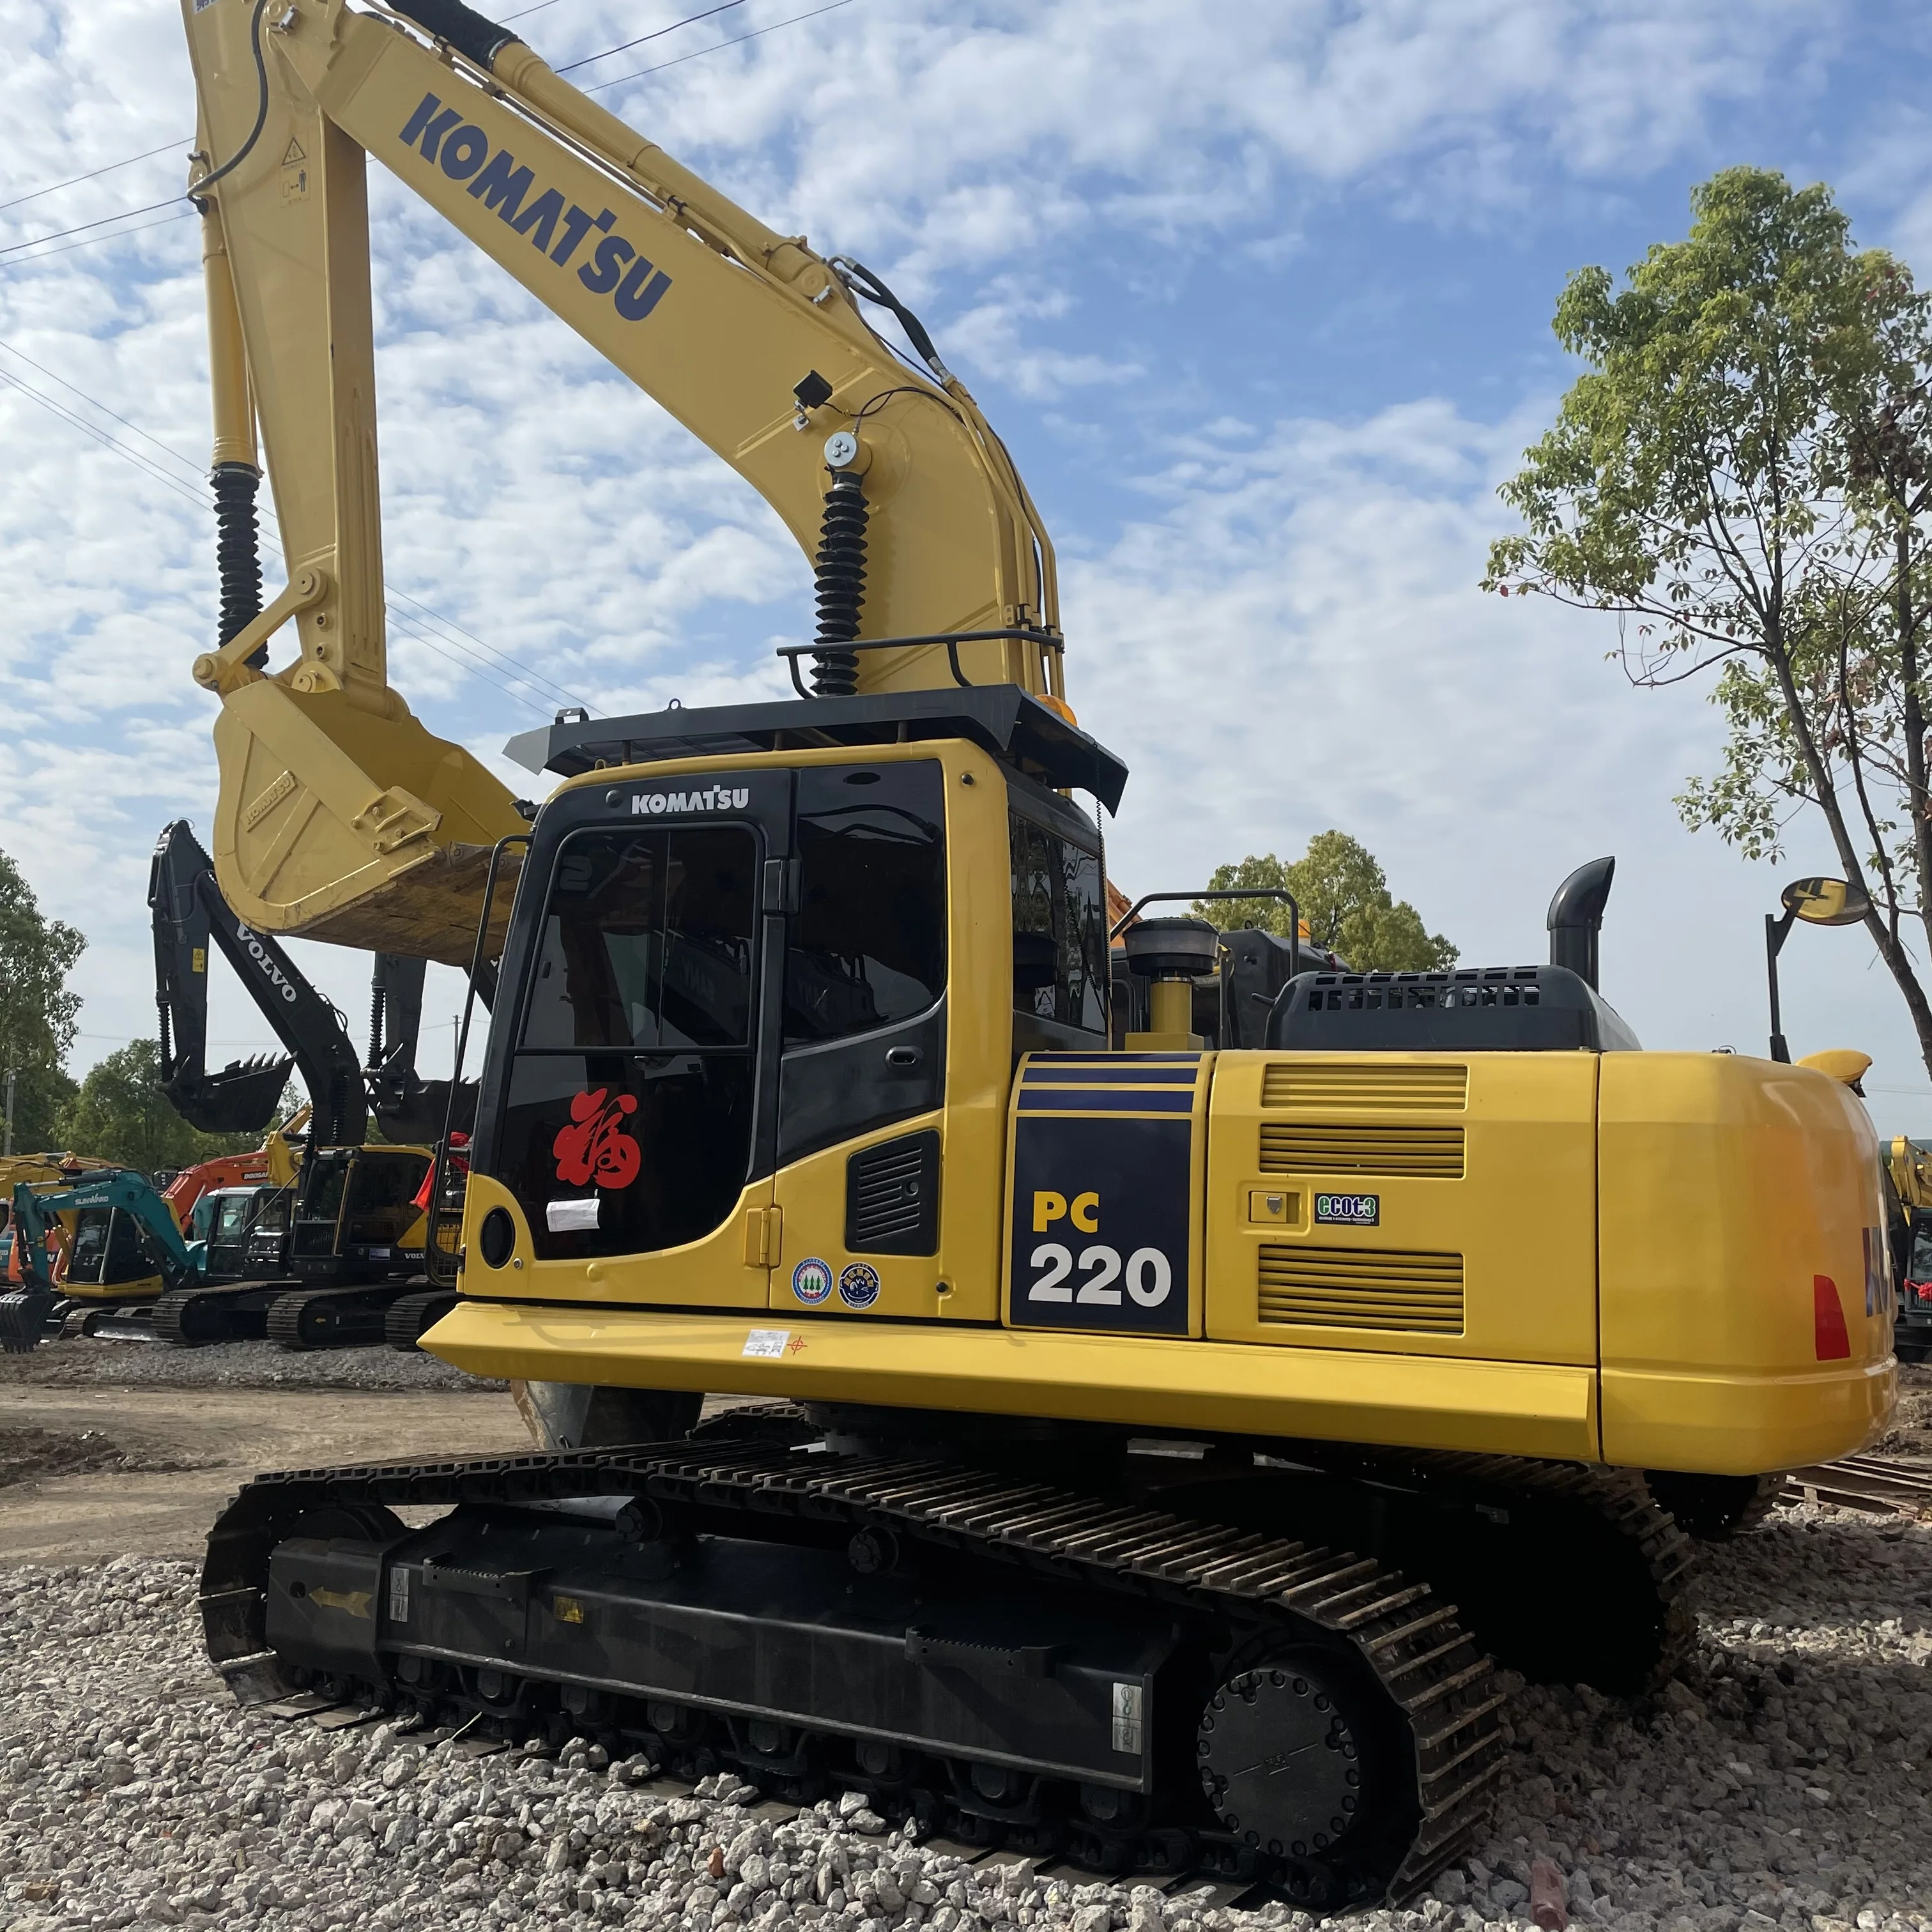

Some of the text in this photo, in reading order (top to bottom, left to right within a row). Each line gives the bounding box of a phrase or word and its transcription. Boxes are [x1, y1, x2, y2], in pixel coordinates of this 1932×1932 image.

[399, 92, 673, 321] KOMATSU
[632, 785, 749, 815] KOMATSU
[236, 921, 296, 1002] VOLVO
[1032, 1191, 1099, 1232] PC
[1318, 1196, 1376, 1217] ecot3
[1028, 1243, 1172, 1307] 220
